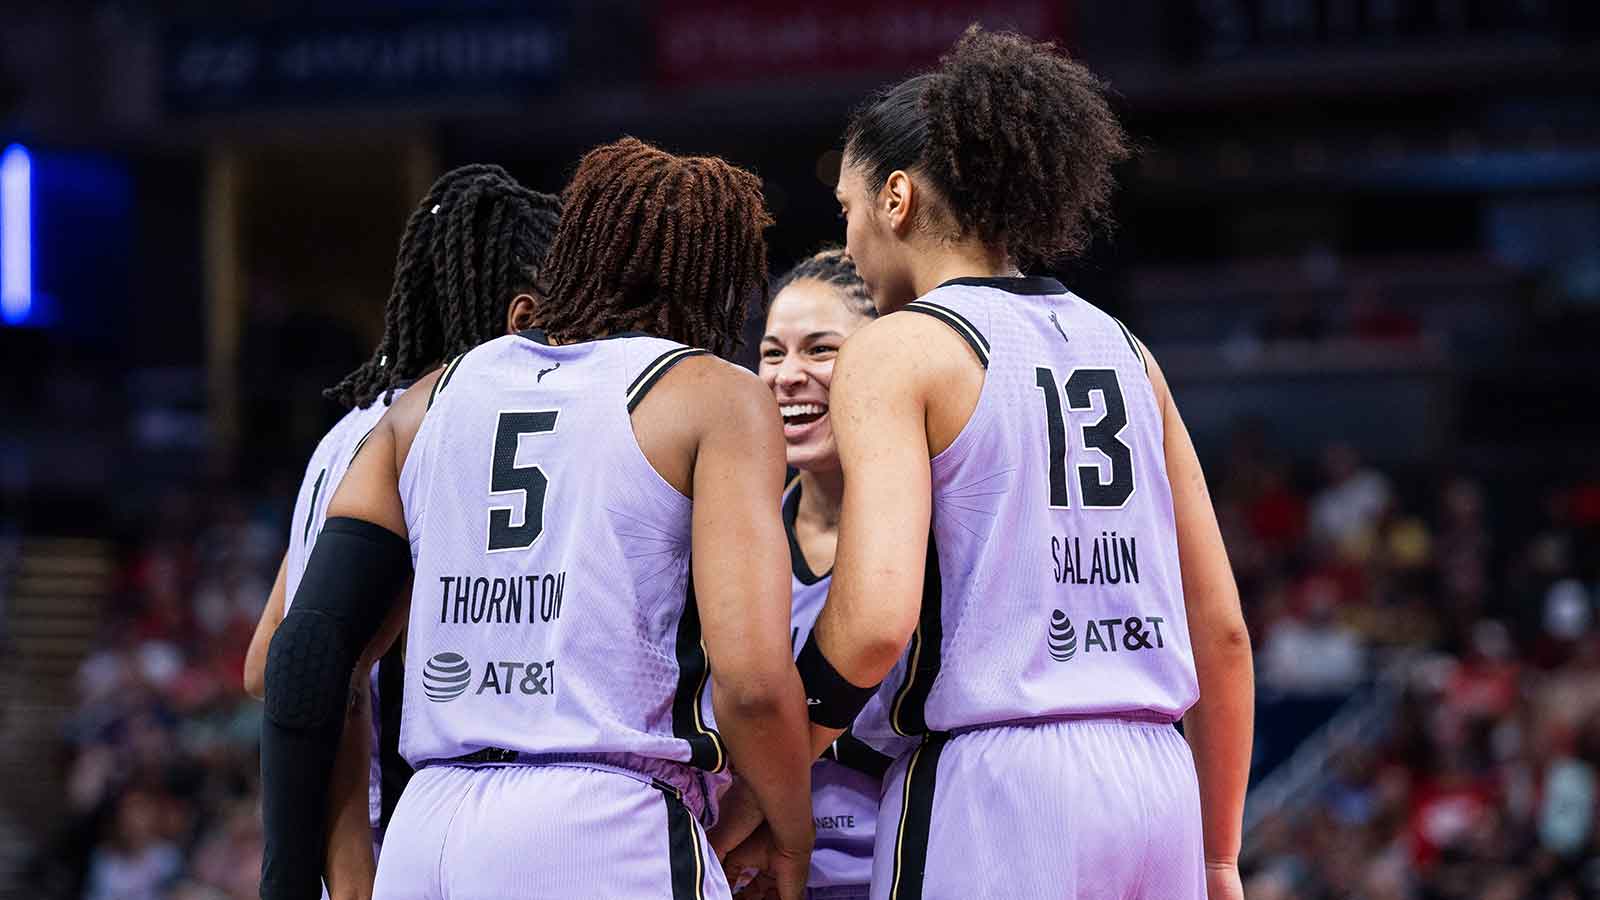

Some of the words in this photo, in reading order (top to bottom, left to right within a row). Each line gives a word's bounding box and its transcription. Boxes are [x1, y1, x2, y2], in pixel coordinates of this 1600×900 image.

[1034, 366, 1136, 509] 13
[487, 408, 561, 553] 5
[1051, 531, 1140, 585] SALAÜN
[439, 571, 566, 624] THORNTON
[1084, 616, 1164, 652] AT&T
